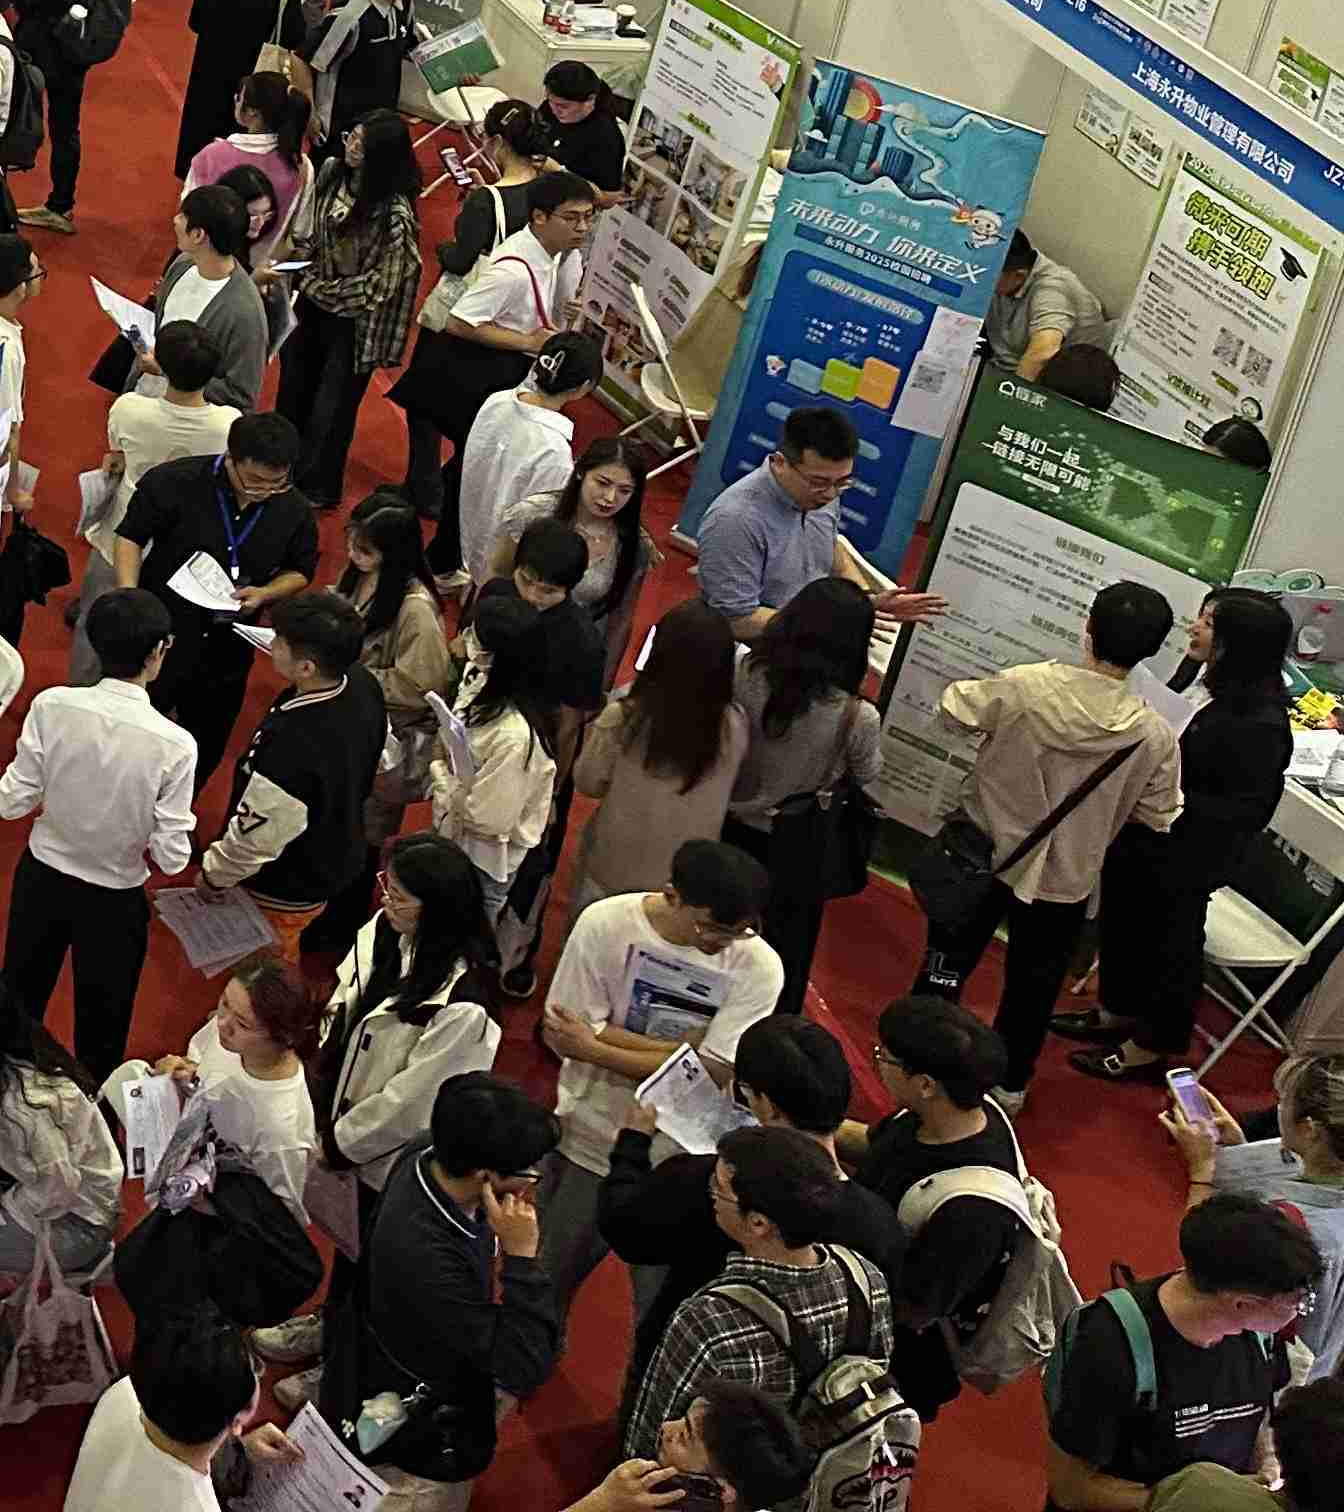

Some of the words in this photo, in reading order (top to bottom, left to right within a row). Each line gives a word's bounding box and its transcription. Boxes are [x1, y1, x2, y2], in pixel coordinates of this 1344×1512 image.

[1130, 61, 1296, 186] 上海永升物业管理有限公司
[1323, 166, 1344, 191] JZ
[785, 199, 881, 246] 未来动力
[886, 235, 989, 284] 你来定义
[997, 424, 1090, 474] 与我们一起
